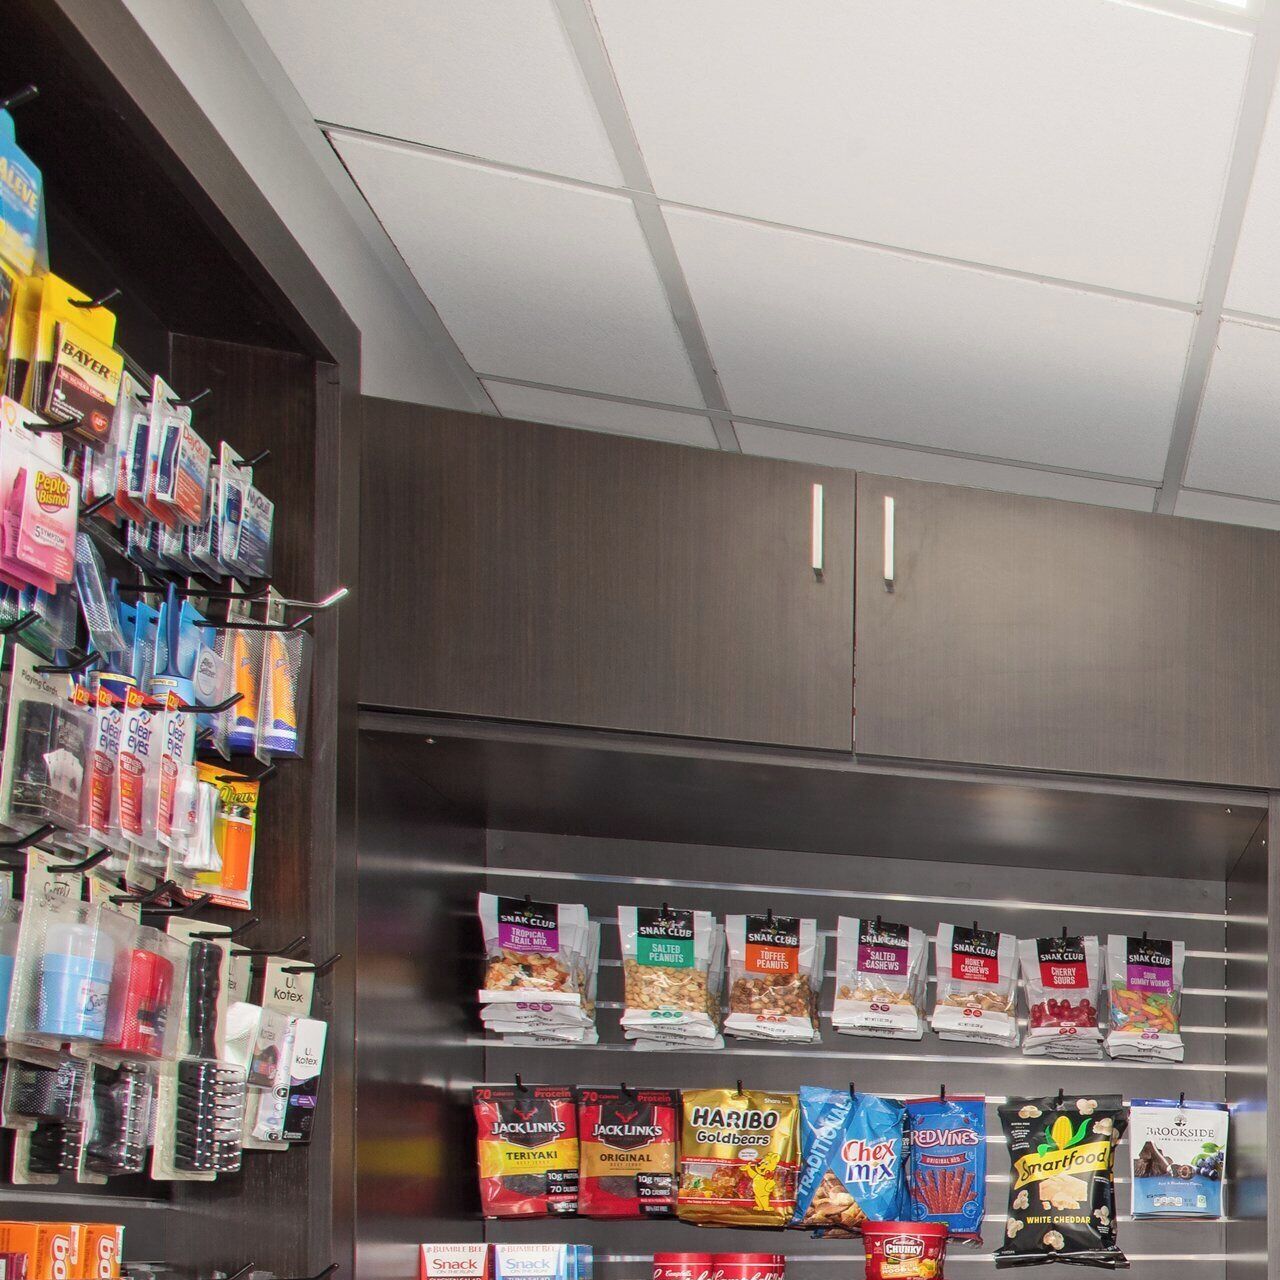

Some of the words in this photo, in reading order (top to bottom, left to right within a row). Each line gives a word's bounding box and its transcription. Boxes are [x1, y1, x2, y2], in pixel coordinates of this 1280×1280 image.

[62, 341, 111, 379] BAYER
[37, 490, 69, 508] Bismol
[128, 717, 151, 742] Clear
[168, 720, 185, 742] Clear
[127, 735, 149, 756] eyes
[167, 738, 183, 757] eyes
[500, 913, 523, 925] SNAK
[525, 916, 556, 930] CLUB
[511, 927, 546, 938] TROPICAL
[640, 926, 667, 936] SNAK
[669, 927, 692, 938] CLUB
[511, 936, 533, 945] TRAIL
[535, 937, 547, 946] MIX
[748, 933, 772, 943] SNAK
[773, 934, 798, 946] CLUB
[651, 943, 681, 954] SALTED
[649, 952, 684, 963] PEANUTS
[760, 950, 786, 960] TOFFEE
[870, 951, 896, 962] SALTED
[1128, 954, 1148, 964] SNAK
[1150, 955, 1171, 965] CLUB
[757, 958, 789, 969] PEANUTS
[865, 959, 899, 971] CASHEWS
[965, 957, 985, 968] HONEY
[960, 965, 989, 975] CASHEWS
[1051, 966, 1076, 977] CHERRY
[1053, 975, 1076, 985] SOURS
[1152, 979, 1170, 988] WORMS
[691, 1107, 779, 1132] HARIBO
[492, 1121, 523, 1136] JACK
[525, 1122, 565, 1134] LINK'S
[1146, 1127, 1215, 1139] BROOKSIDE
[696, 1130, 771, 1146] Goldbears
[797, 1101, 852, 1197] TRADITIONAL
[841, 1137, 895, 1163] Chex
[506, 1150, 558, 1161] TERIYAKI
[599, 1152, 652, 1163] ORIGINAL
[925, 1157, 949, 1166] ORIGINAL
[1020, 1146, 1111, 1186] Smartfood
[844, 1159, 894, 1185] mix
[1026, 1215, 1053, 1224] WHITE
[1054, 1215, 1091, 1224] CHEDDAR
[885, 1244, 922, 1255] CHUNKY
[433, 1259, 478, 1270] Snack
